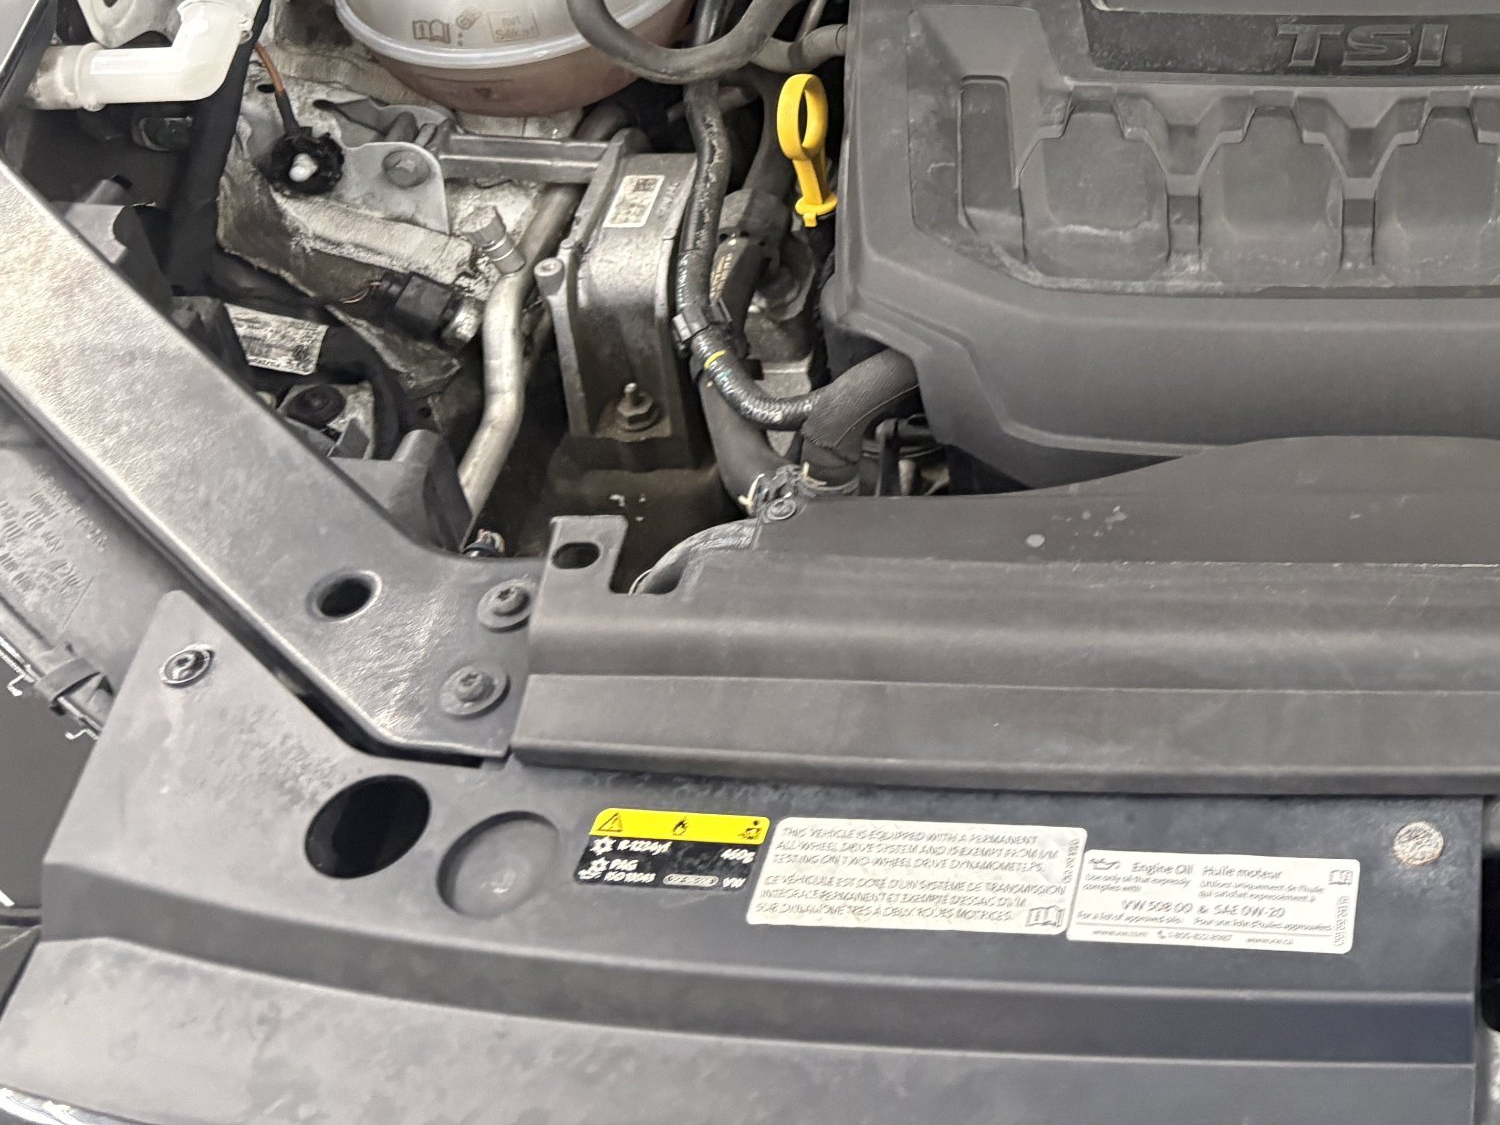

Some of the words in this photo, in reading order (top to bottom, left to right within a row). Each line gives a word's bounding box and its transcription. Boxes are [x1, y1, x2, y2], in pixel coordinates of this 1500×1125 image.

[1277, 23, 1448, 67] TSI
[782, 827, 807, 838] THIS
[809, 828, 856, 839] VEHICLE
[968, 834, 1039, 846] PERMANENT
[609, 858, 639, 871] PAG
[1131, 861, 1174, 876] Engine
[1174, 863, 1194, 875] Oil
[1202, 865, 1236, 877] Huile
[1236, 868, 1283, 880] moteur
[722, 877, 747, 888] VW
[1121, 899, 1147, 911] VW
[1147, 900, 1172, 912] 508
[1213, 904, 1240, 916] SAE
